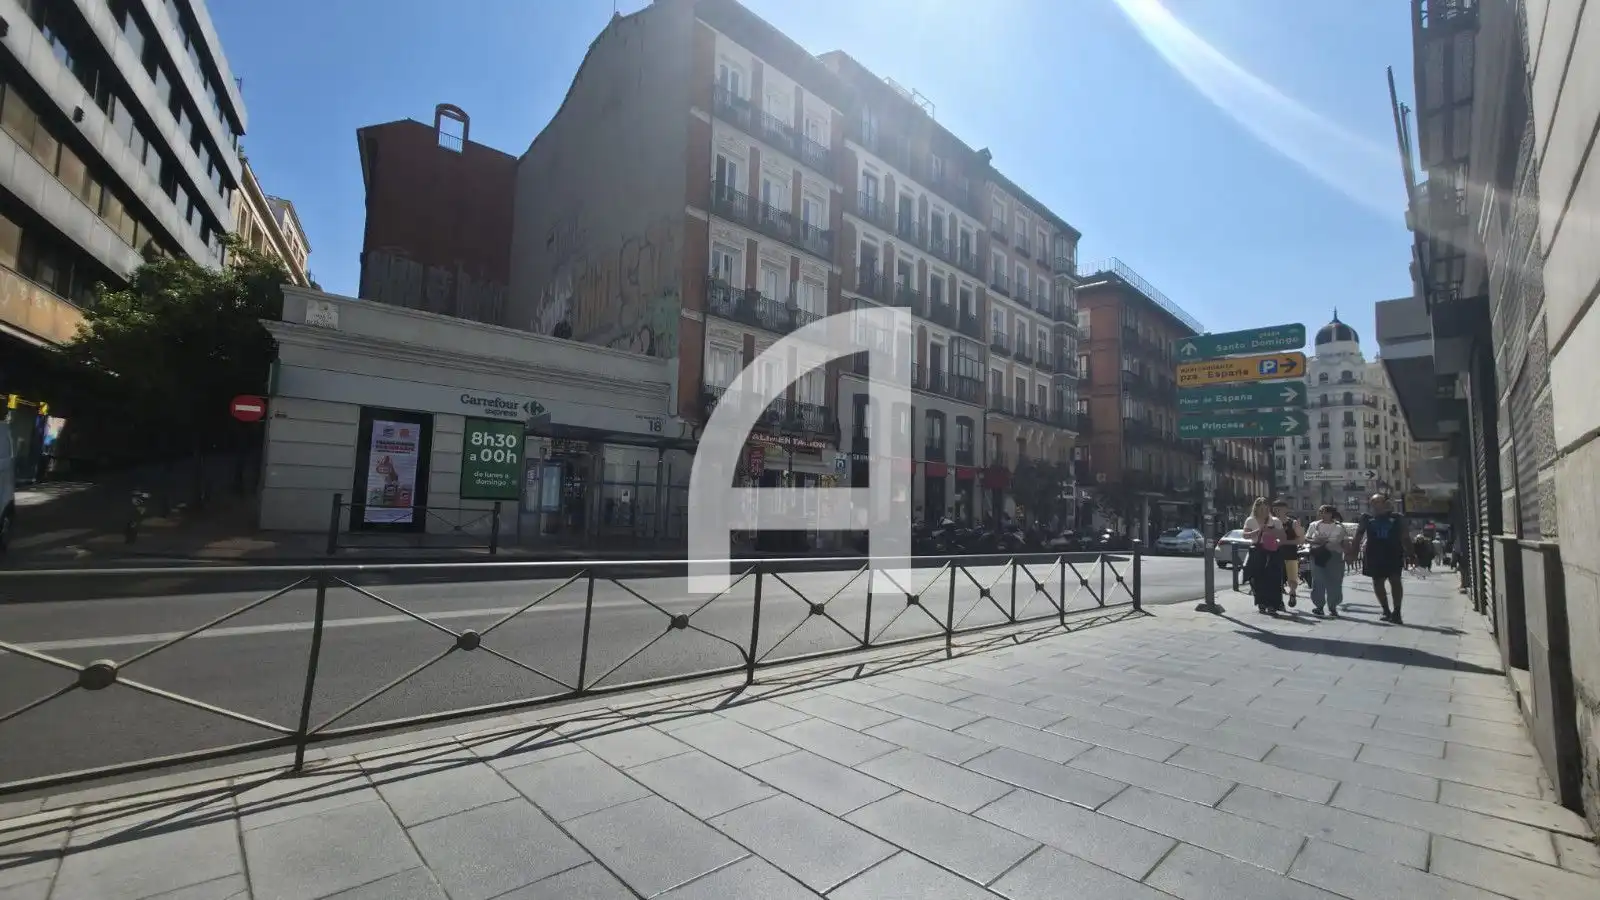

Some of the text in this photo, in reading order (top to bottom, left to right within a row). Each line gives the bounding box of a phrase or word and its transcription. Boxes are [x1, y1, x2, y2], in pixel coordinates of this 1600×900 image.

[1216, 336, 1299, 352] Santo Domingo
[1207, 369, 1249, 379] España
[460, 394, 518, 409] Carrefour
[1215, 393, 1253, 403] España
[484, 408, 518, 417] express
[648, 420, 662, 432] 18
[1202, 421, 1245, 430] Princesa
[471, 431, 517, 448] 8h30
[469, 449, 517, 464] a 00h
[484, 471, 503, 479] lunes
